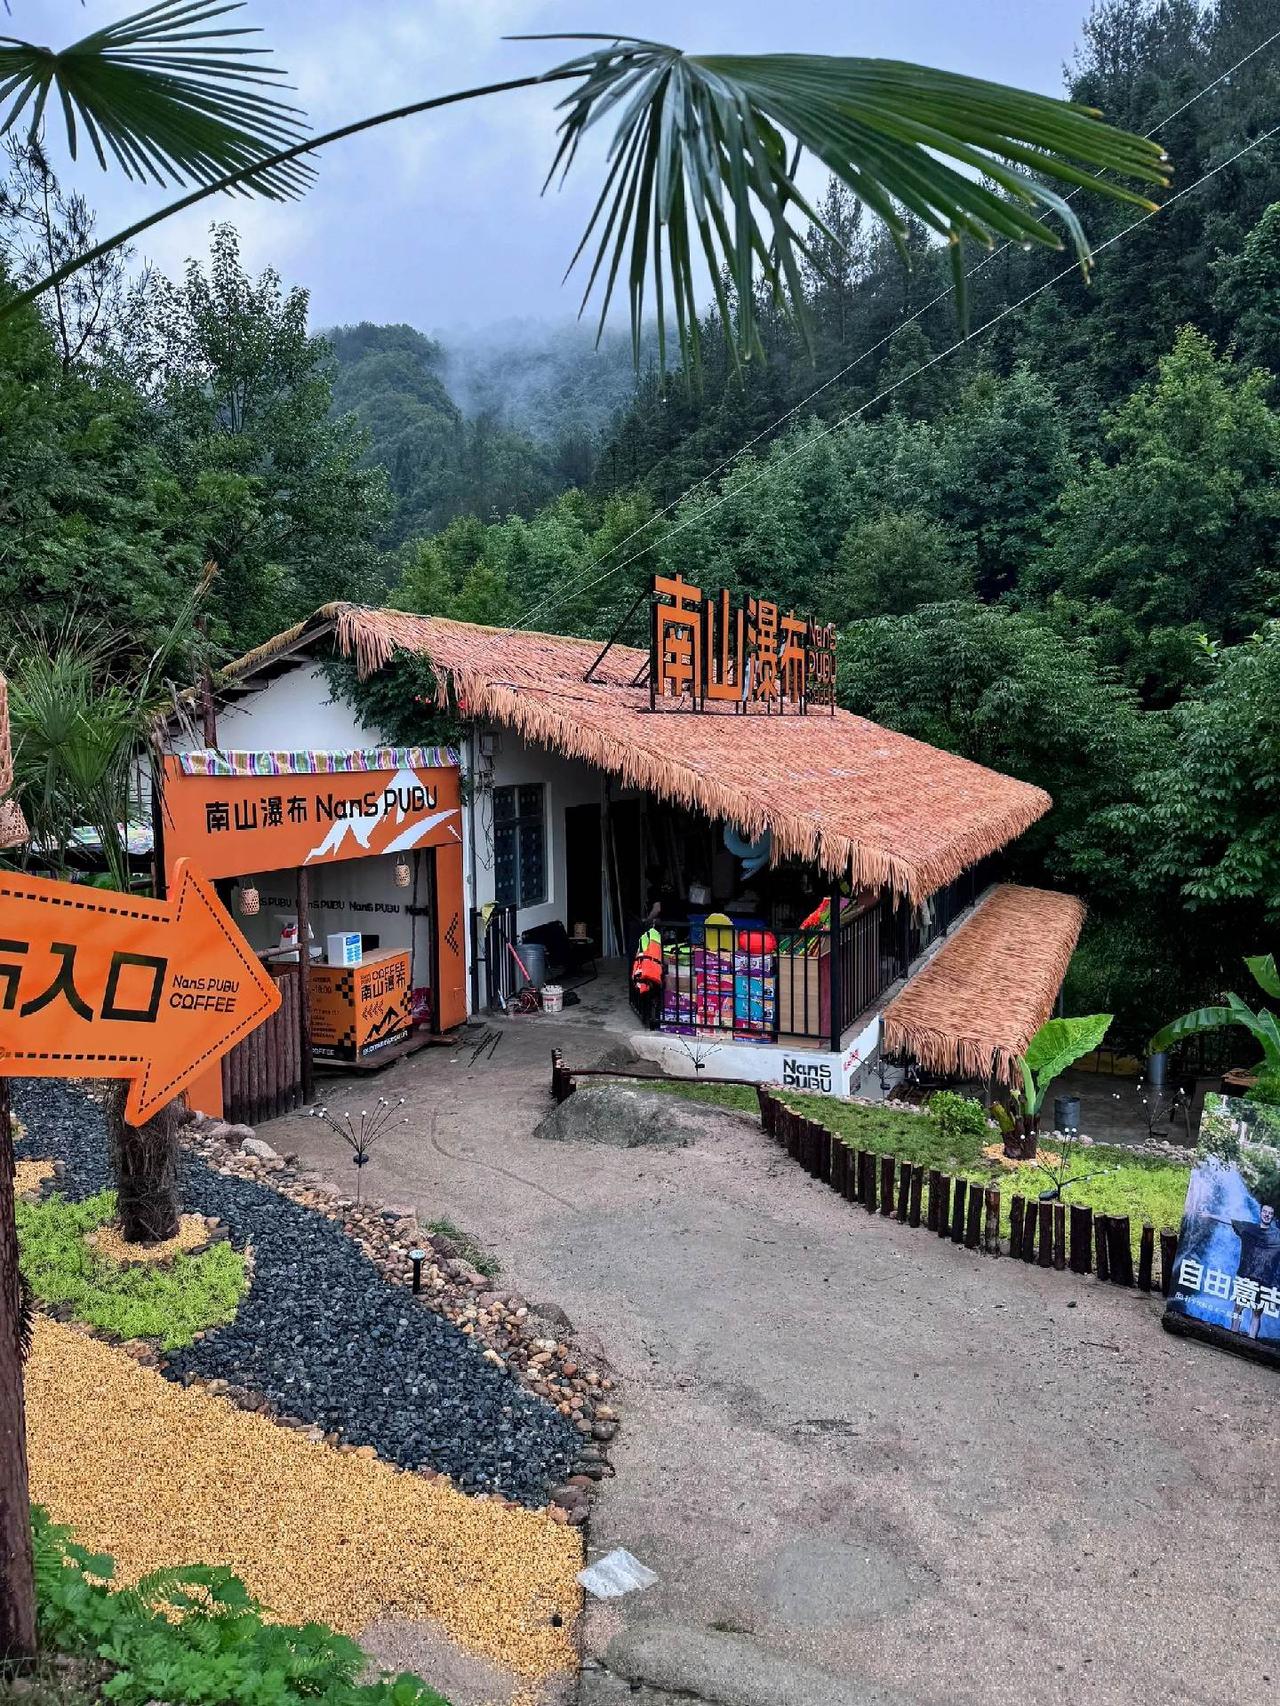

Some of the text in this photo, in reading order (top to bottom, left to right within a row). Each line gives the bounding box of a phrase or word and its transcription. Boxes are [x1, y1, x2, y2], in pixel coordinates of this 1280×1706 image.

[651, 573, 808, 704] 南山瀑布
[205, 795, 308, 834] 南山瀑布
[315, 785, 438, 823] NanS PUBU
[372, 961, 405, 981] COFFEE
[172, 974, 240, 994] NanS PUBU
[169, 992, 237, 1013] COFFEE
[783, 1058, 832, 1078] NanS
[783, 1074, 832, 1093] PUBU
[1178, 1258, 1280, 1319] 自由意志
